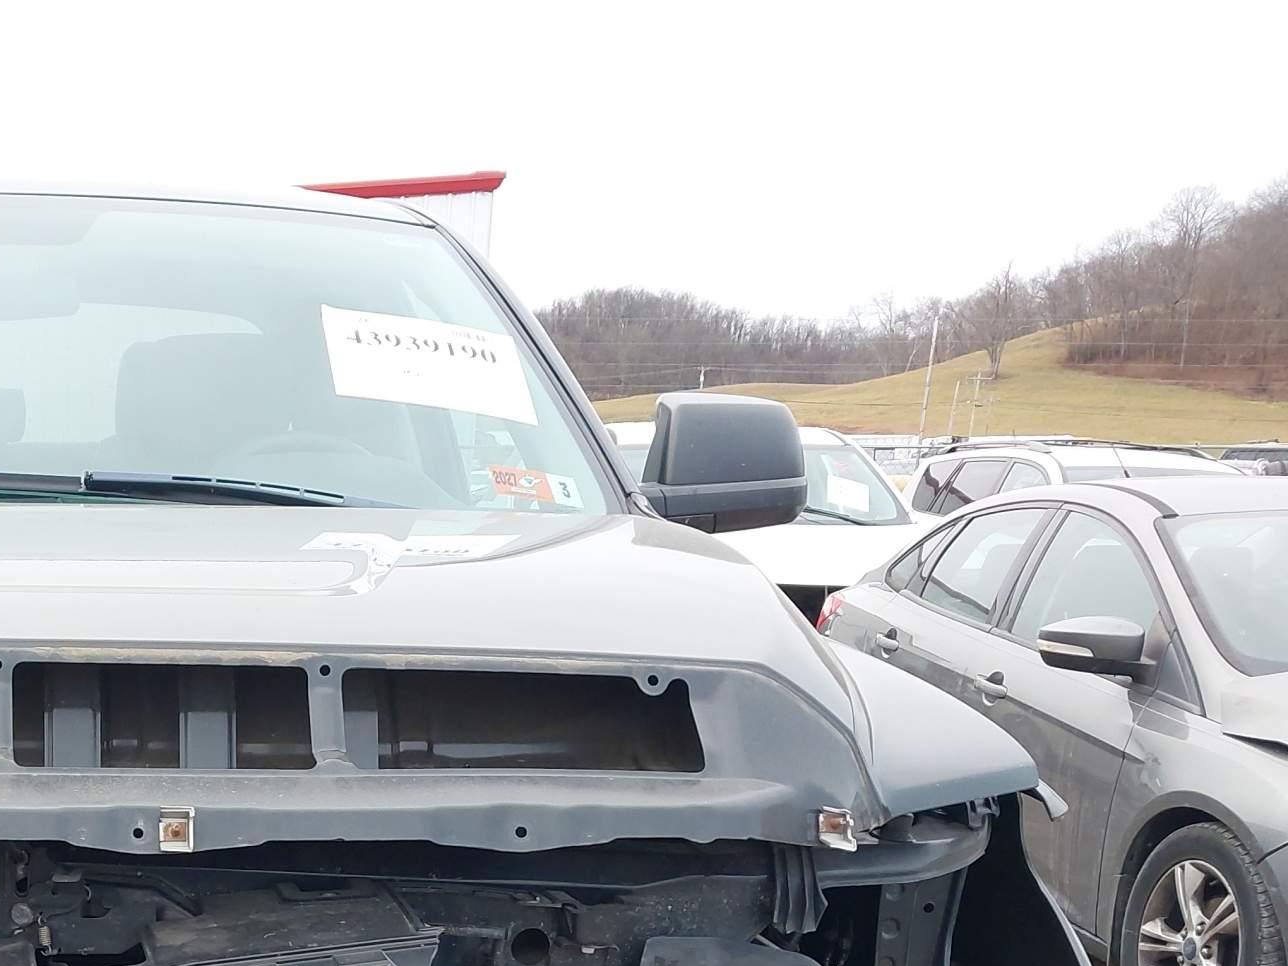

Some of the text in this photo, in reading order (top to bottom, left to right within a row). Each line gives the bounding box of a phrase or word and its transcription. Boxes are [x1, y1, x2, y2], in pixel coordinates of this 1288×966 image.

[345, 329, 497, 364] 43939190
[492, 470, 571, 498] 2027 3
